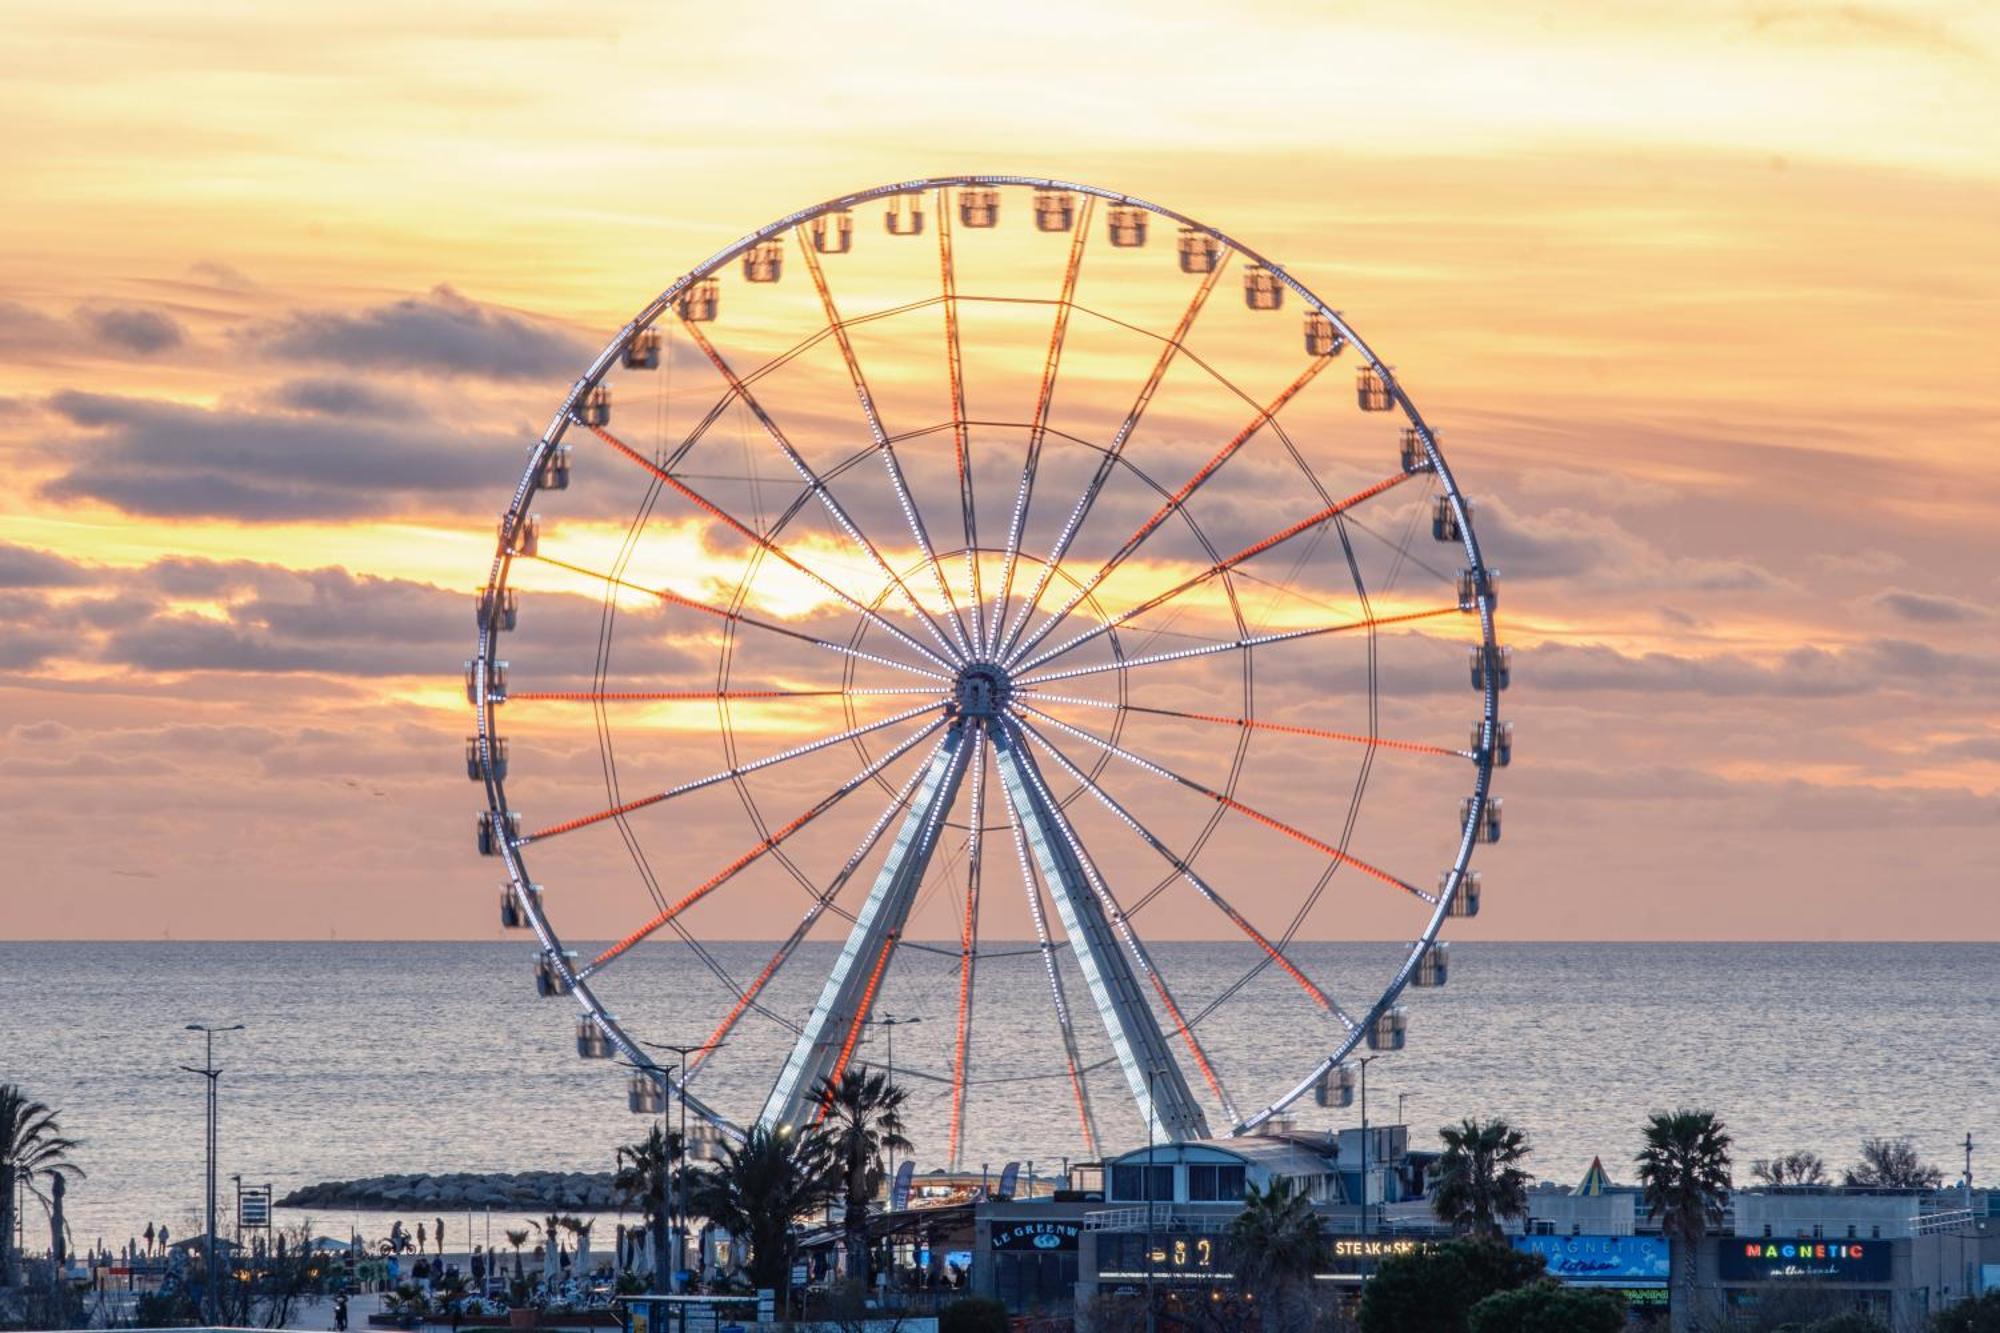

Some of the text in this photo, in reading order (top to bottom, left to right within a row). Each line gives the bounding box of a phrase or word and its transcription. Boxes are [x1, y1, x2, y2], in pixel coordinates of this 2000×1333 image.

[992, 1232, 1010, 1247] LE
[1335, 1241, 1381, 1256] STEAK
[1531, 1241, 1652, 1254] MAGNETIC
[1745, 1244, 1863, 1258] MAGNETIC
